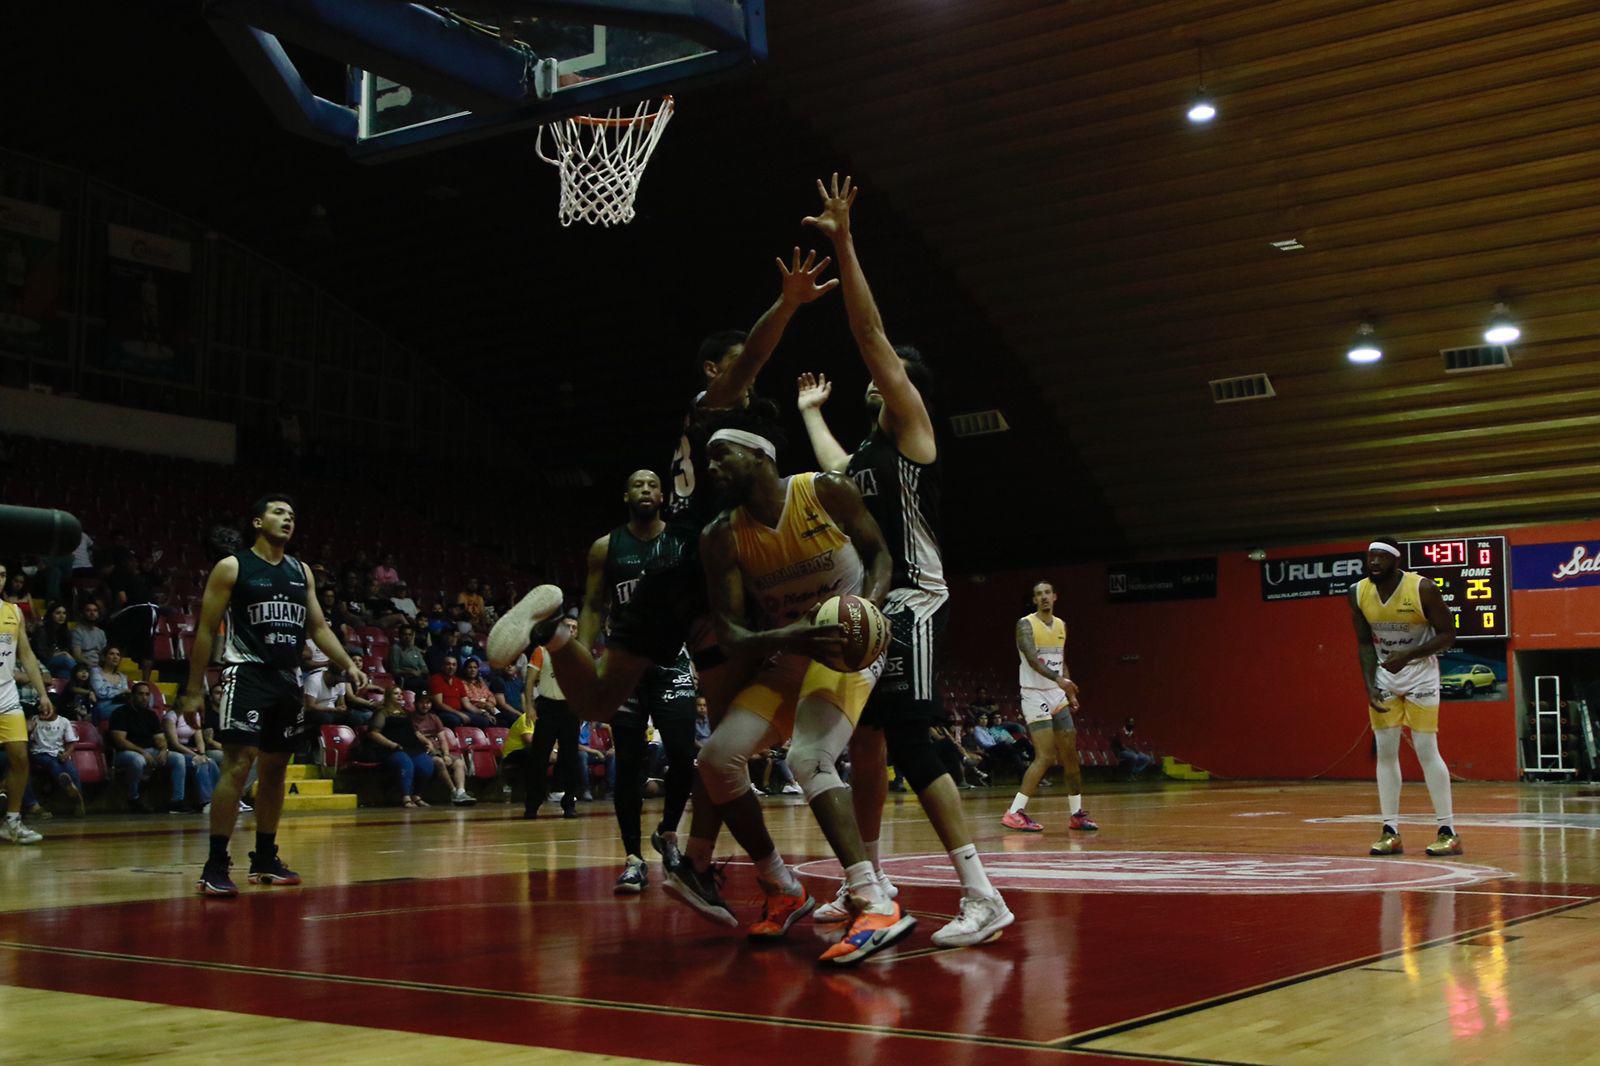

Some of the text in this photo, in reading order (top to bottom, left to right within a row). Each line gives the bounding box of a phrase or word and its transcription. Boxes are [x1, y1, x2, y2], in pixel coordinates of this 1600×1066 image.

[1424, 543, 1464, 562] 4:37
[1479, 549, 1491, 565] 0
[1461, 567, 1493, 577] HOME
[1466, 579, 1492, 599] 25
[247, 601, 307, 628] TIJUANA
[1483, 612, 1494, 628] 0
[288, 783, 299, 794] A
